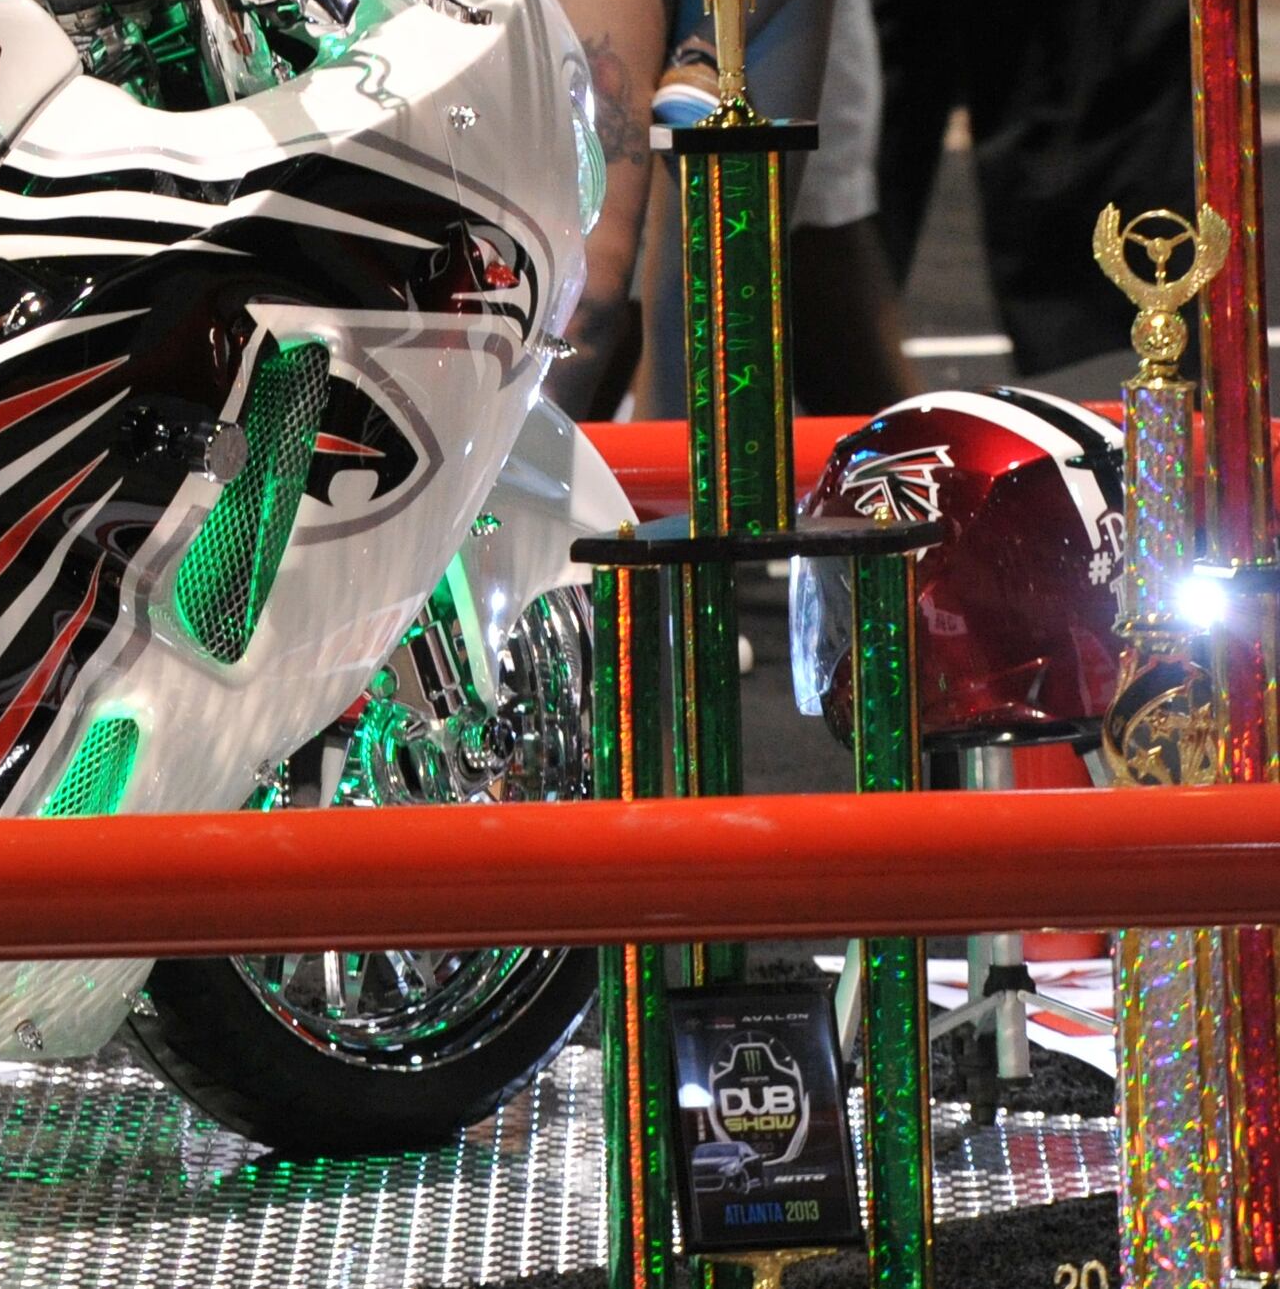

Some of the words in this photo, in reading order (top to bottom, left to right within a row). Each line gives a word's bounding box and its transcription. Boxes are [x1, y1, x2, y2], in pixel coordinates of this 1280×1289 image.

[741, 1013, 809, 1023] AVALON
[719, 1085, 796, 1116] DUB
[724, 1115, 797, 1132] SHOW
[724, 1202, 784, 1225] ATLANTA
[785, 1199, 820, 1222] 2013
